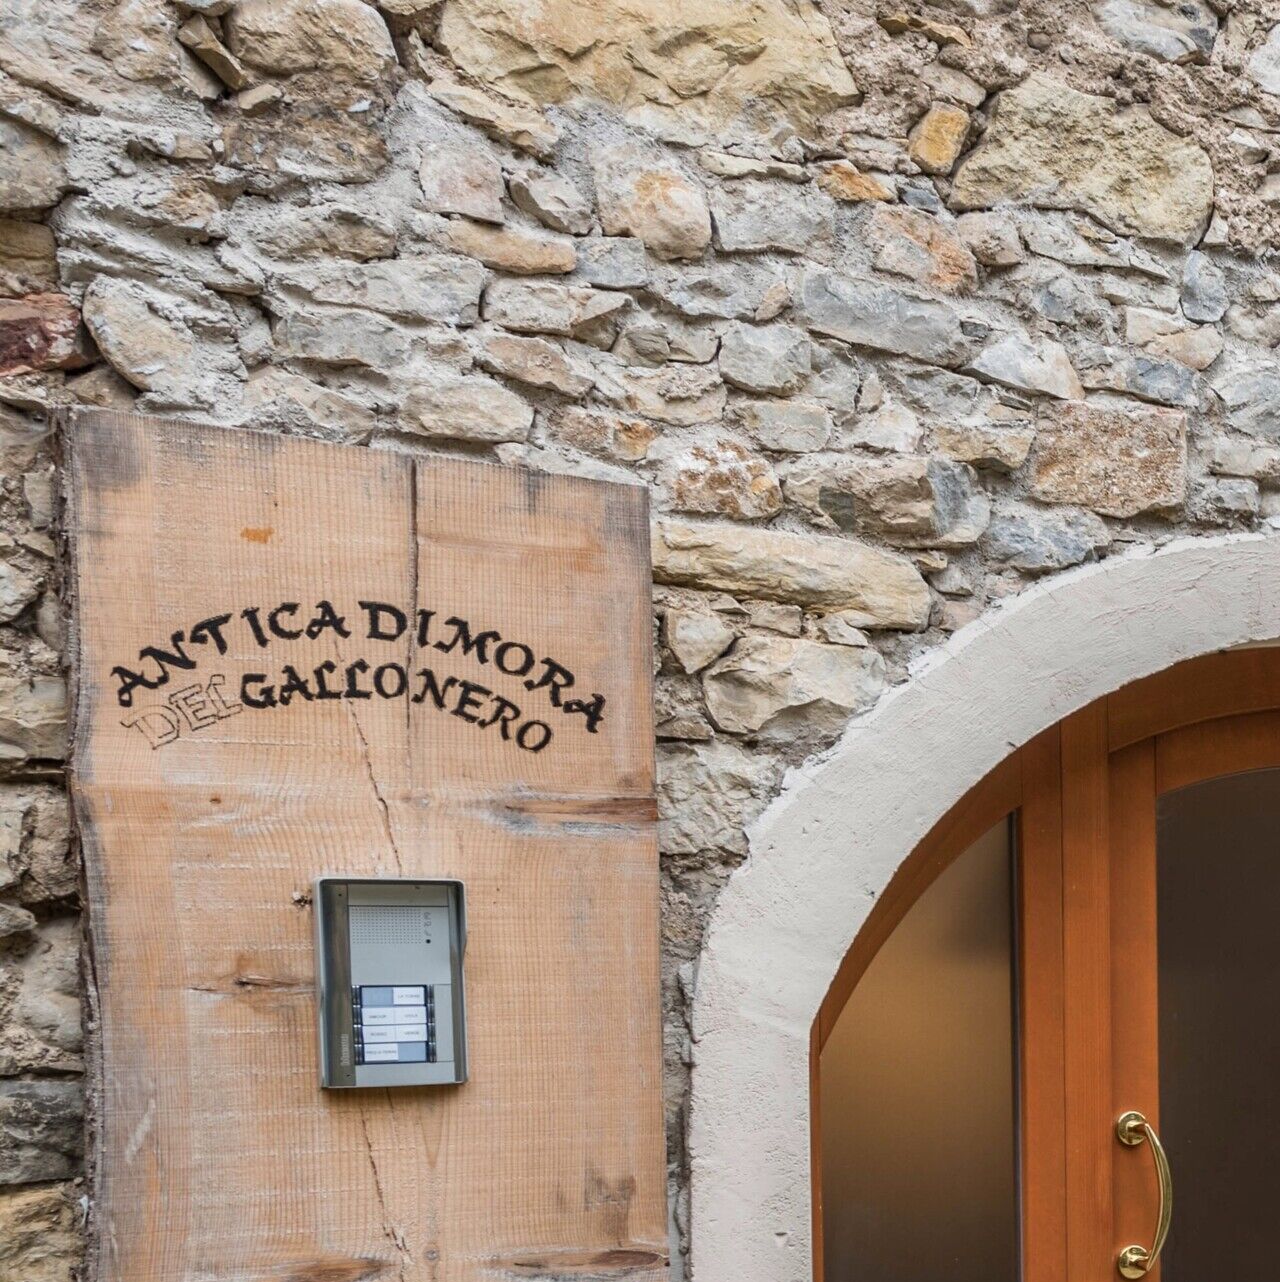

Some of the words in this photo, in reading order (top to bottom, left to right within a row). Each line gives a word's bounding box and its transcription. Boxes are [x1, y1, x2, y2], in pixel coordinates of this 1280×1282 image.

[111, 600, 352, 708] ANTICA
[358, 600, 607, 733] DIMORA
[119, 675, 243, 751] DEL
[240, 658, 408, 710] GALLO
[411, 668, 553, 753] NERO
